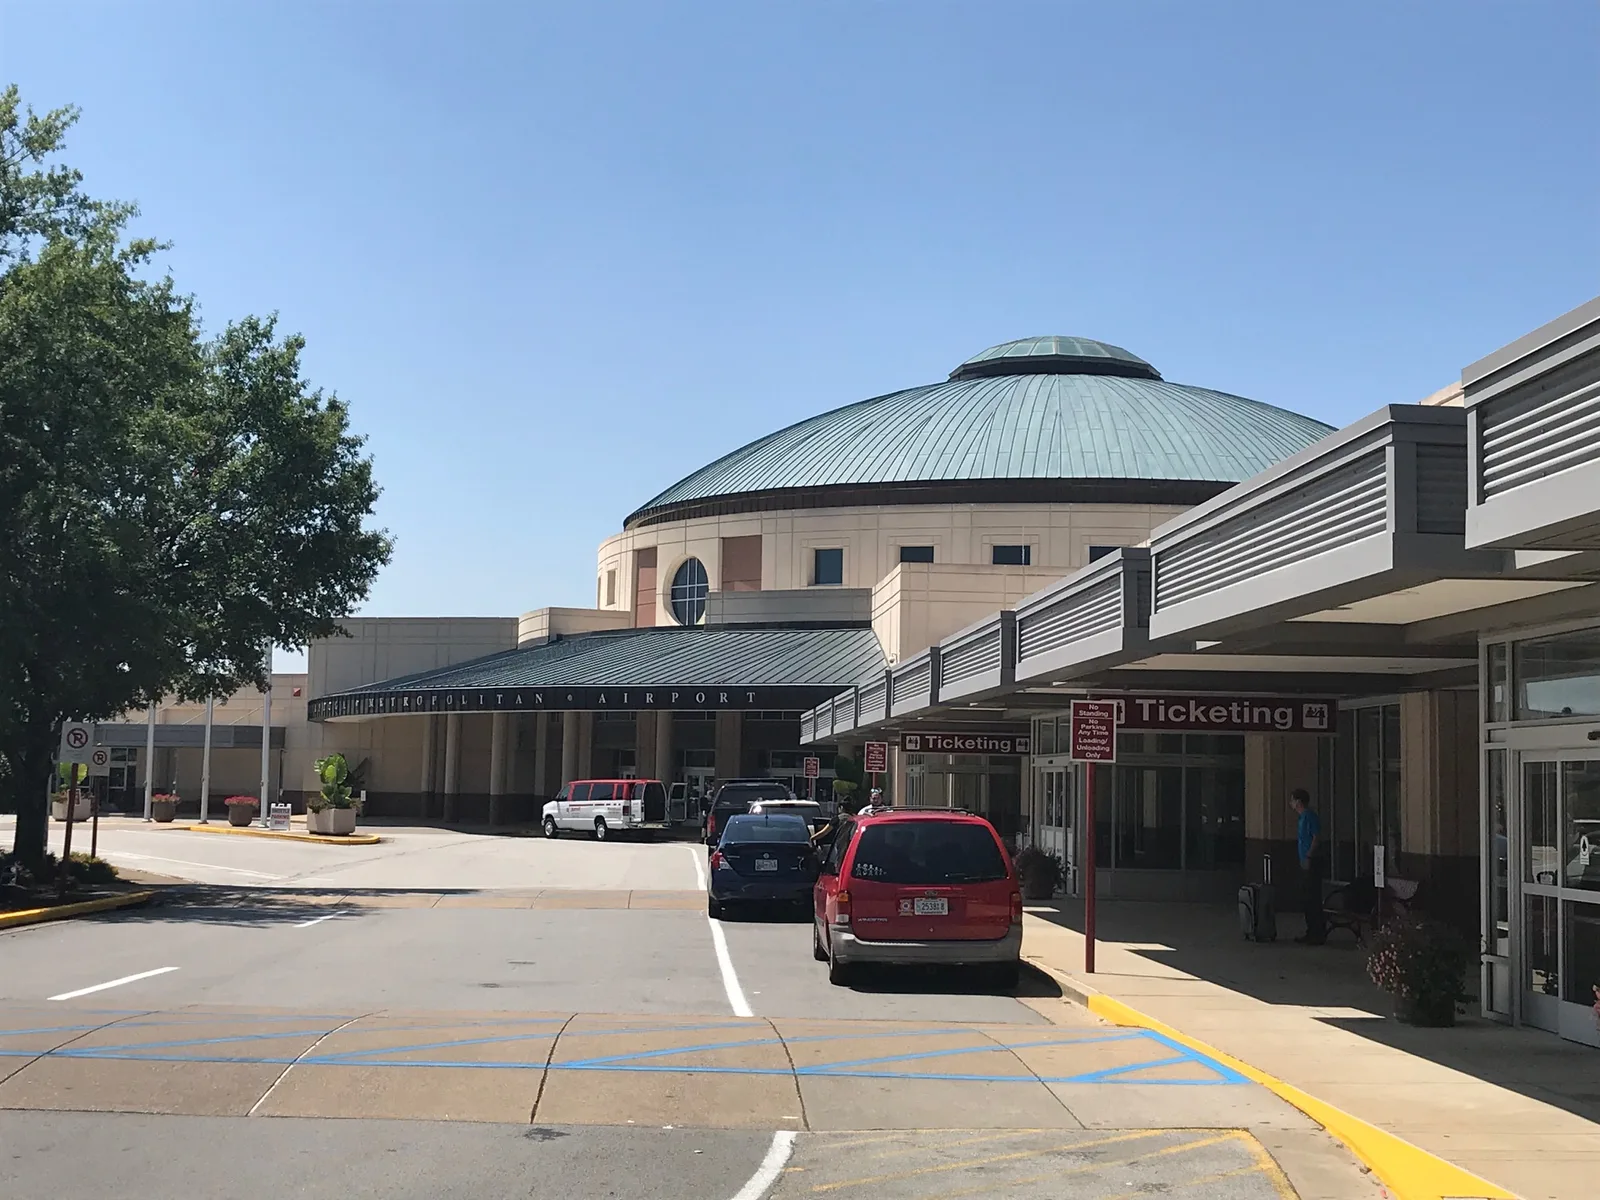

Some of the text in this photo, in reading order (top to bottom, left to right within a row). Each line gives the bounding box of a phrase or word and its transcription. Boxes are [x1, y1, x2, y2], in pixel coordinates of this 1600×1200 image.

[368, 692, 544, 708] METROPOLITAN
[598, 691, 756, 704] AIRPORT
[1078, 710, 1109, 718] Standing
[1135, 698, 1293, 730] Ticketing
[1080, 723, 1107, 731] Parking
[925, 735, 1012, 753] Ticketing
[1076, 744, 1110, 752] Unloading
